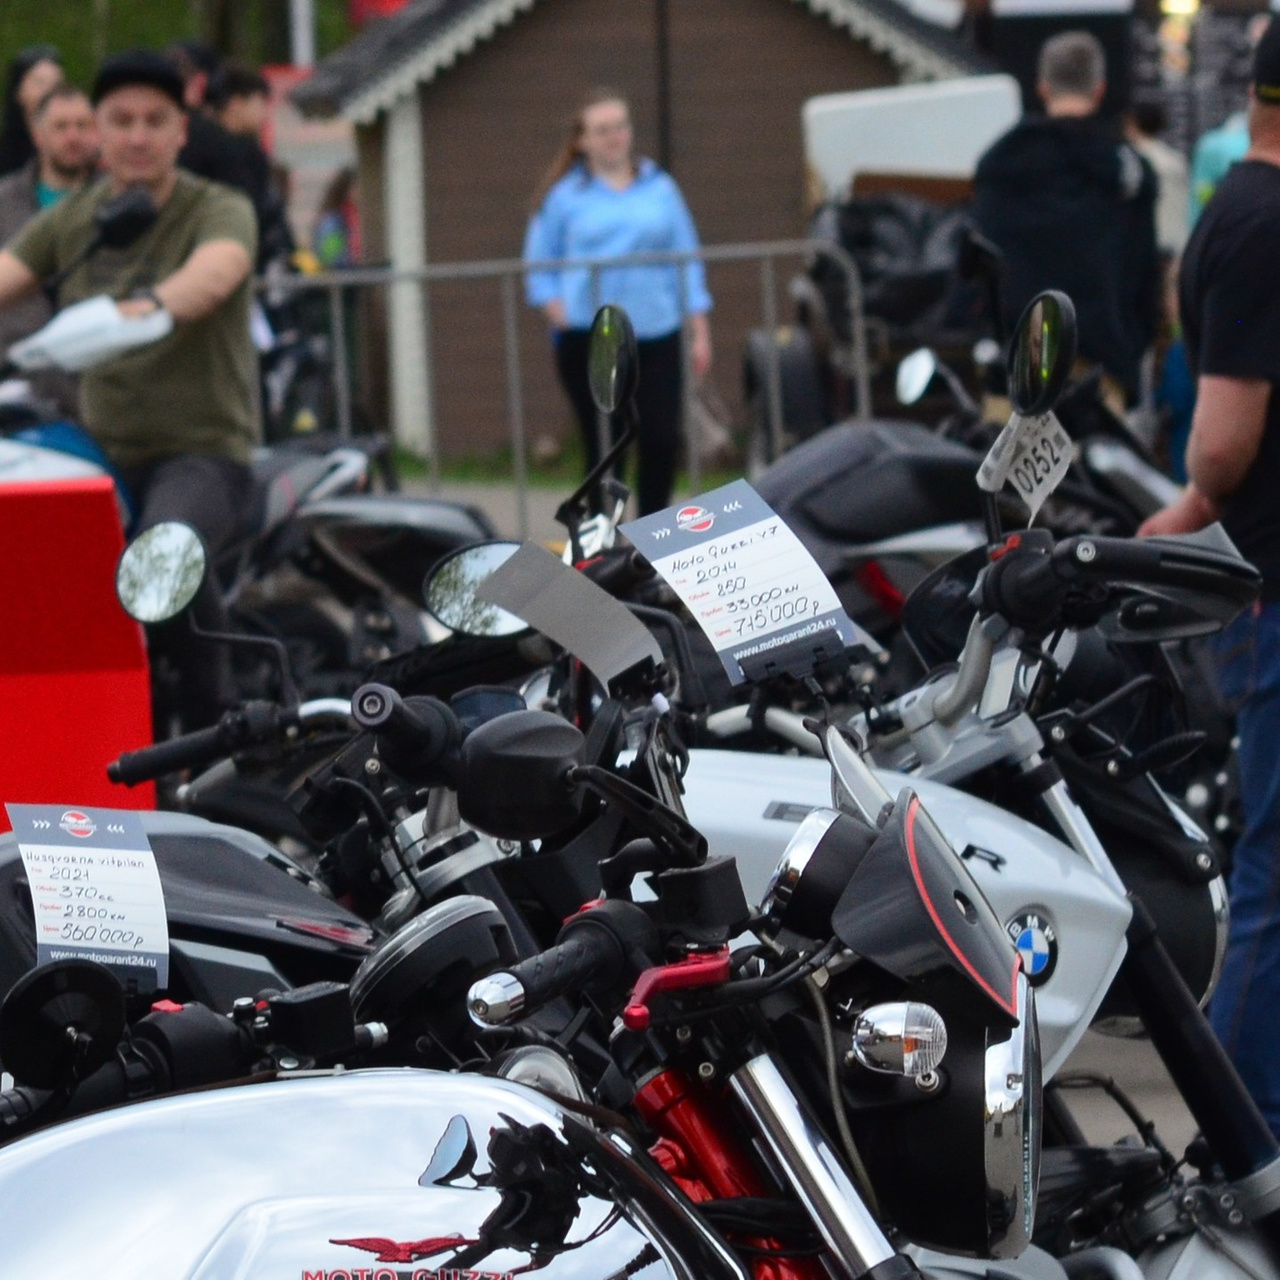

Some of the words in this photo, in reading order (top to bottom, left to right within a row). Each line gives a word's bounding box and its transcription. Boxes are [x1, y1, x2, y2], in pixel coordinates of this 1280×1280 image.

[1015, 438, 1060, 493] 0252
[697, 561, 736, 584] 2014
[49, 866, 90, 881] 2021
[1009, 914, 1054, 942] BMW
[50, 950, 156, 968] wwwmotogarant24.ru
